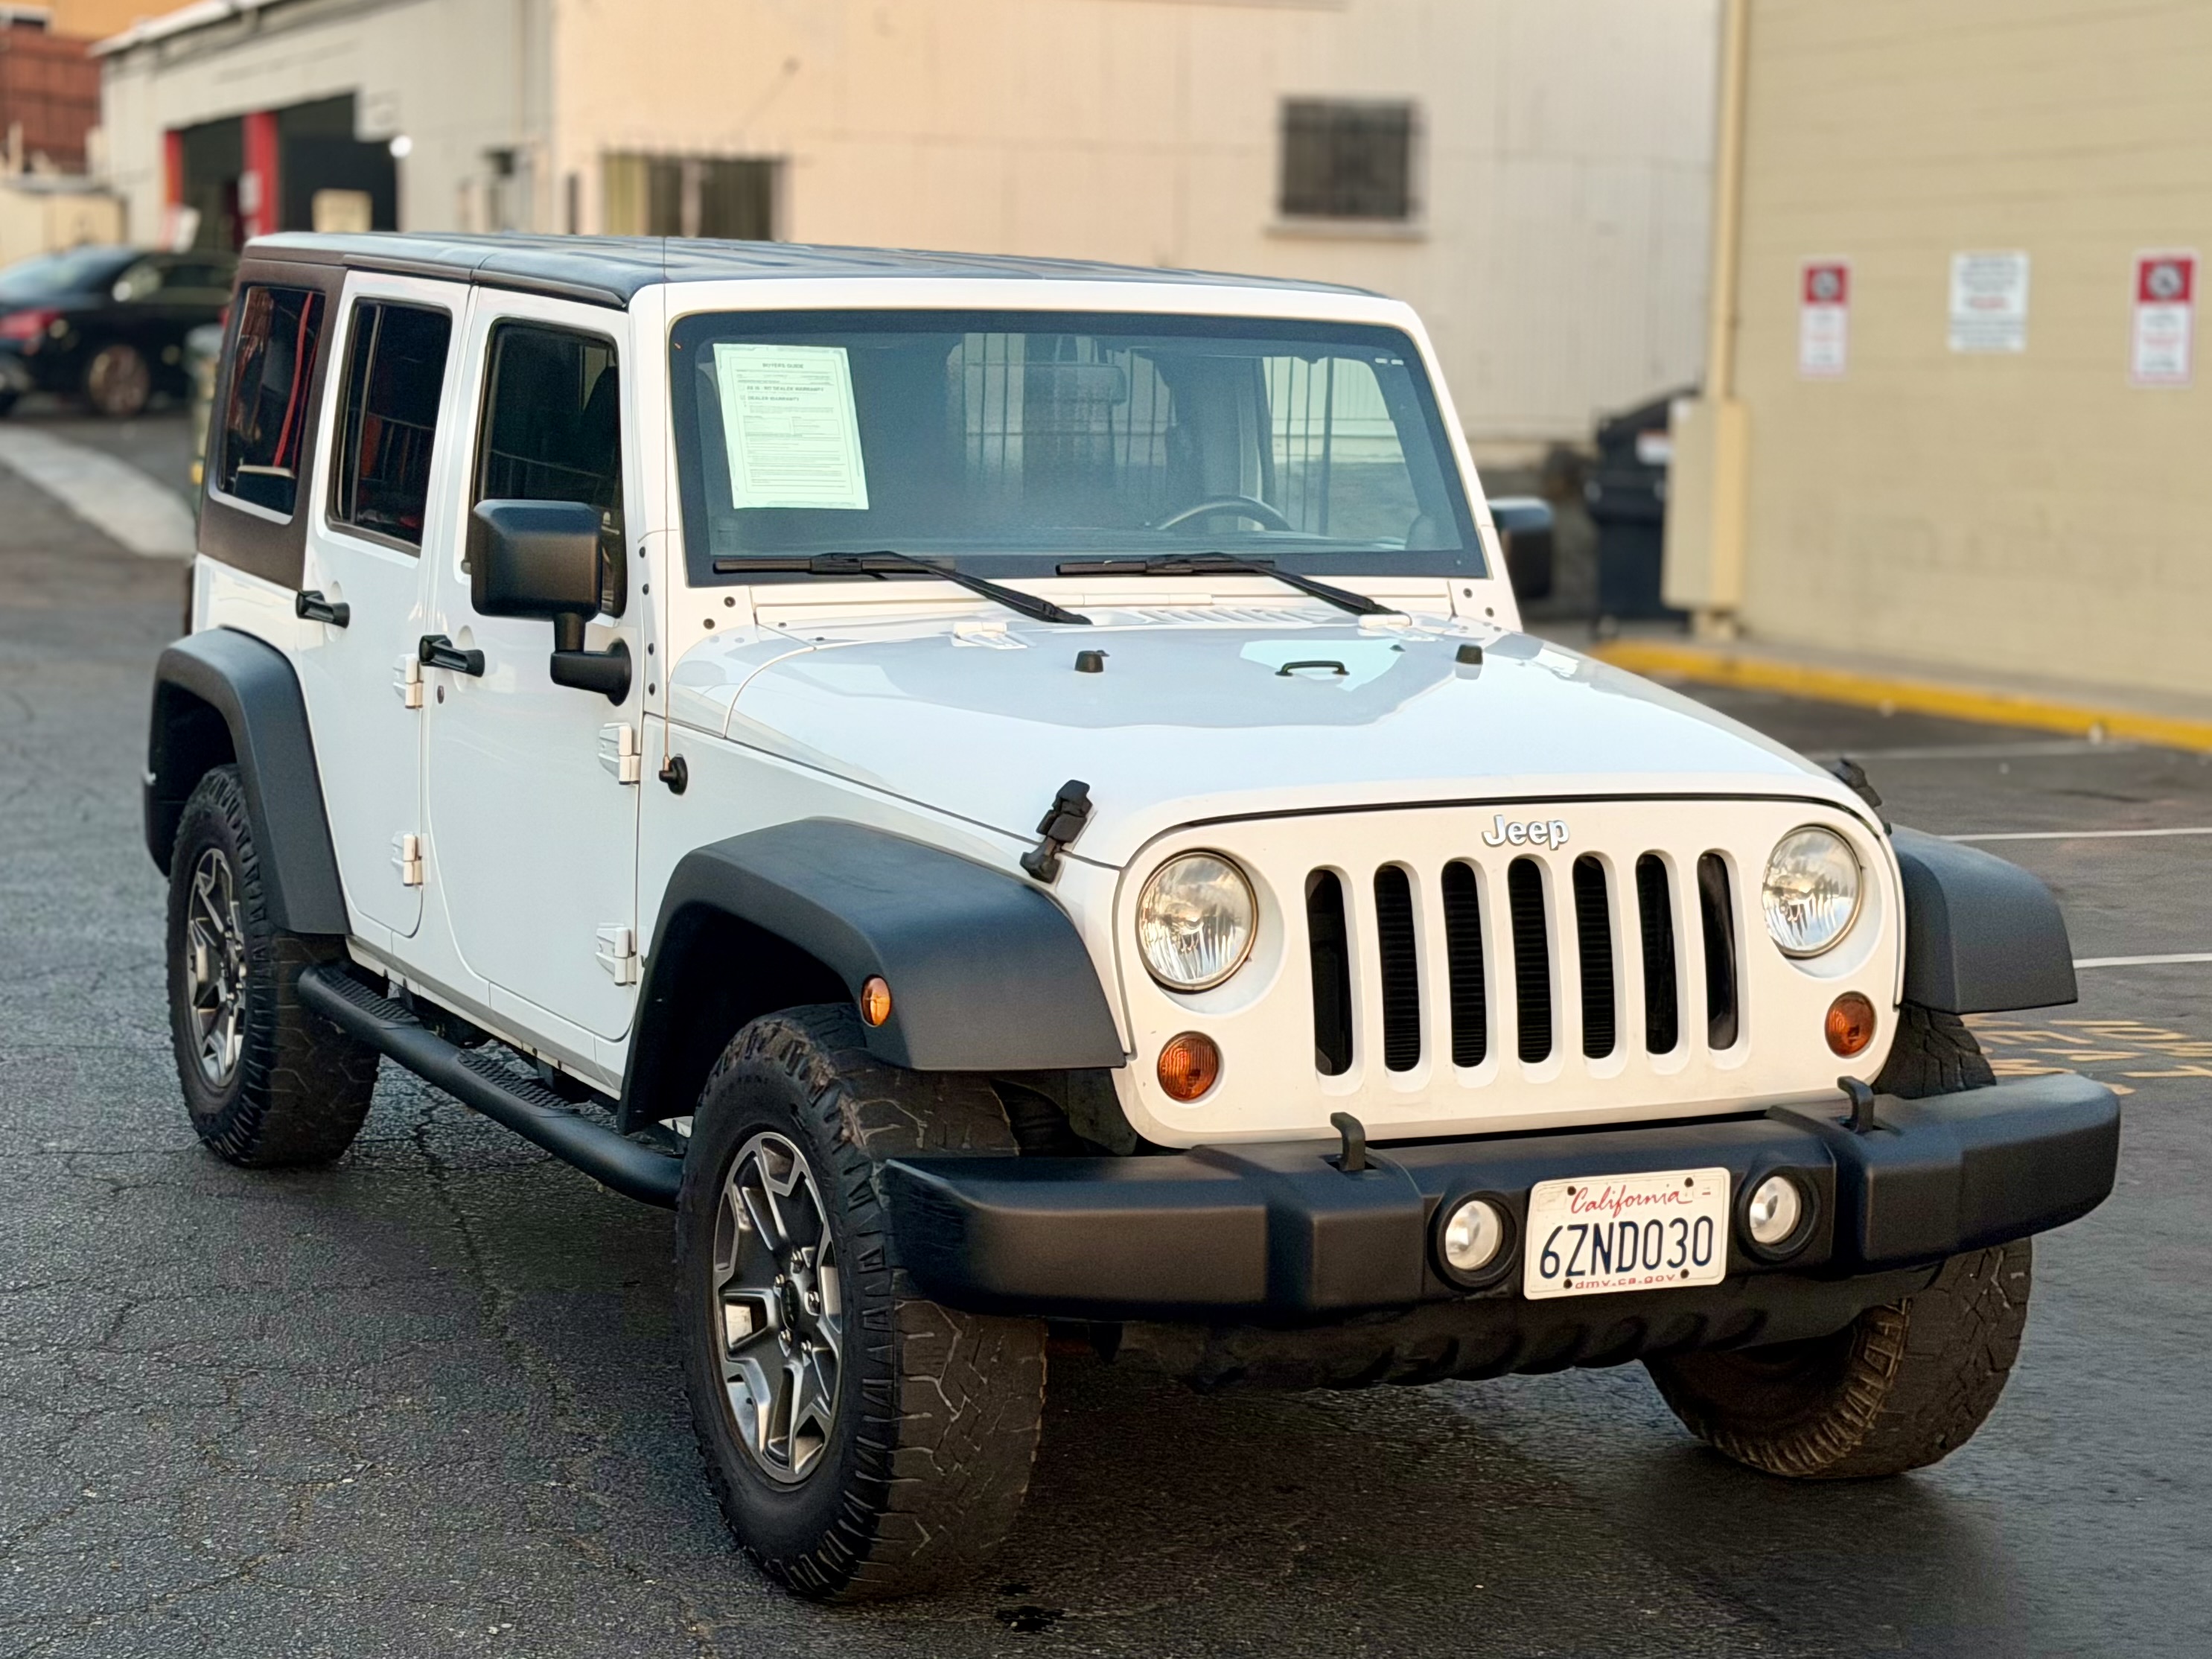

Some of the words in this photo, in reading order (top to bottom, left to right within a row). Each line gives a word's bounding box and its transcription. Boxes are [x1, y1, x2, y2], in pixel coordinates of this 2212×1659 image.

[1482, 814, 1569, 850] Jeep
[1571, 1185, 1692, 1218] California
[1540, 1215, 1713, 1279] 6ZND030
[1575, 1273, 1675, 1290] dmv.ca.gov
